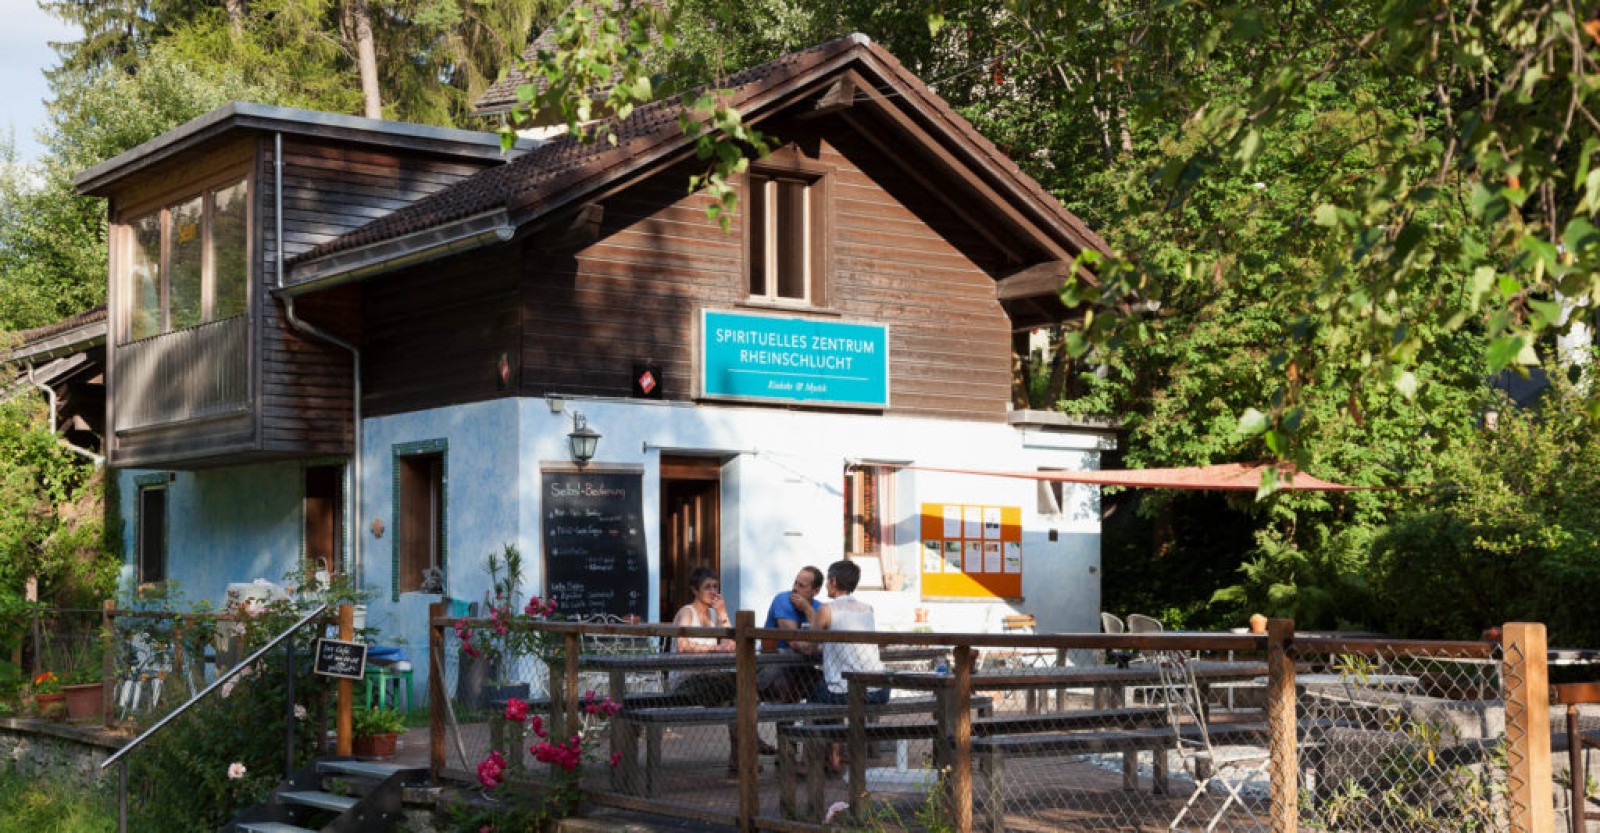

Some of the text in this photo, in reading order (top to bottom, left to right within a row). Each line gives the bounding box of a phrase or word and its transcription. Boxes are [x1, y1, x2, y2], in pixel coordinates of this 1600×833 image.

[716, 329, 874, 354] SPIRITUELLES ZENTRUM
[740, 350, 853, 370] RHEINSCHLUCHT
[795, 382, 804, 392] &
